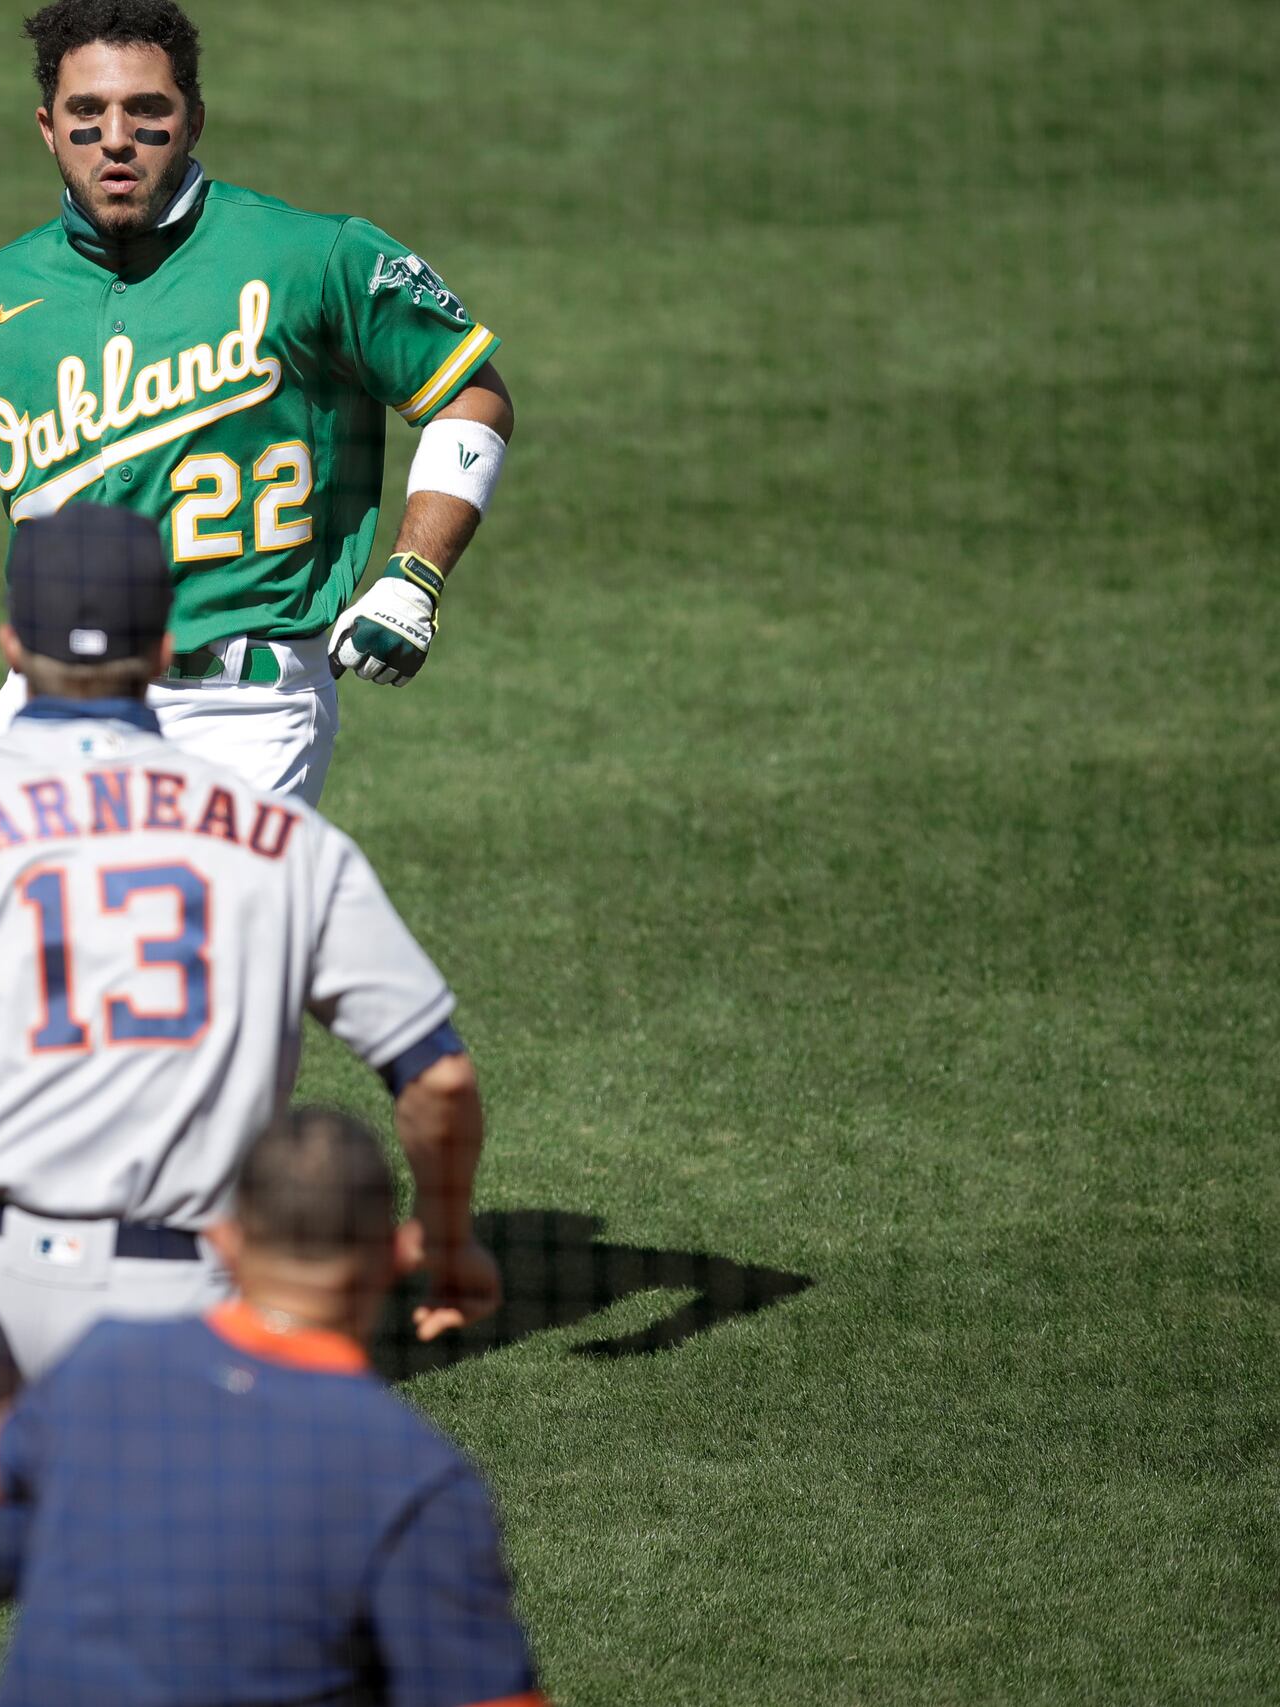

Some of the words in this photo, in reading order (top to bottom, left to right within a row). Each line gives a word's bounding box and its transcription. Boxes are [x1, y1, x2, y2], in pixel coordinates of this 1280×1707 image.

[171, 440, 313, 563] 22
[373, 611, 430, 643] EASTON
[16, 860, 211, 1054] 13
